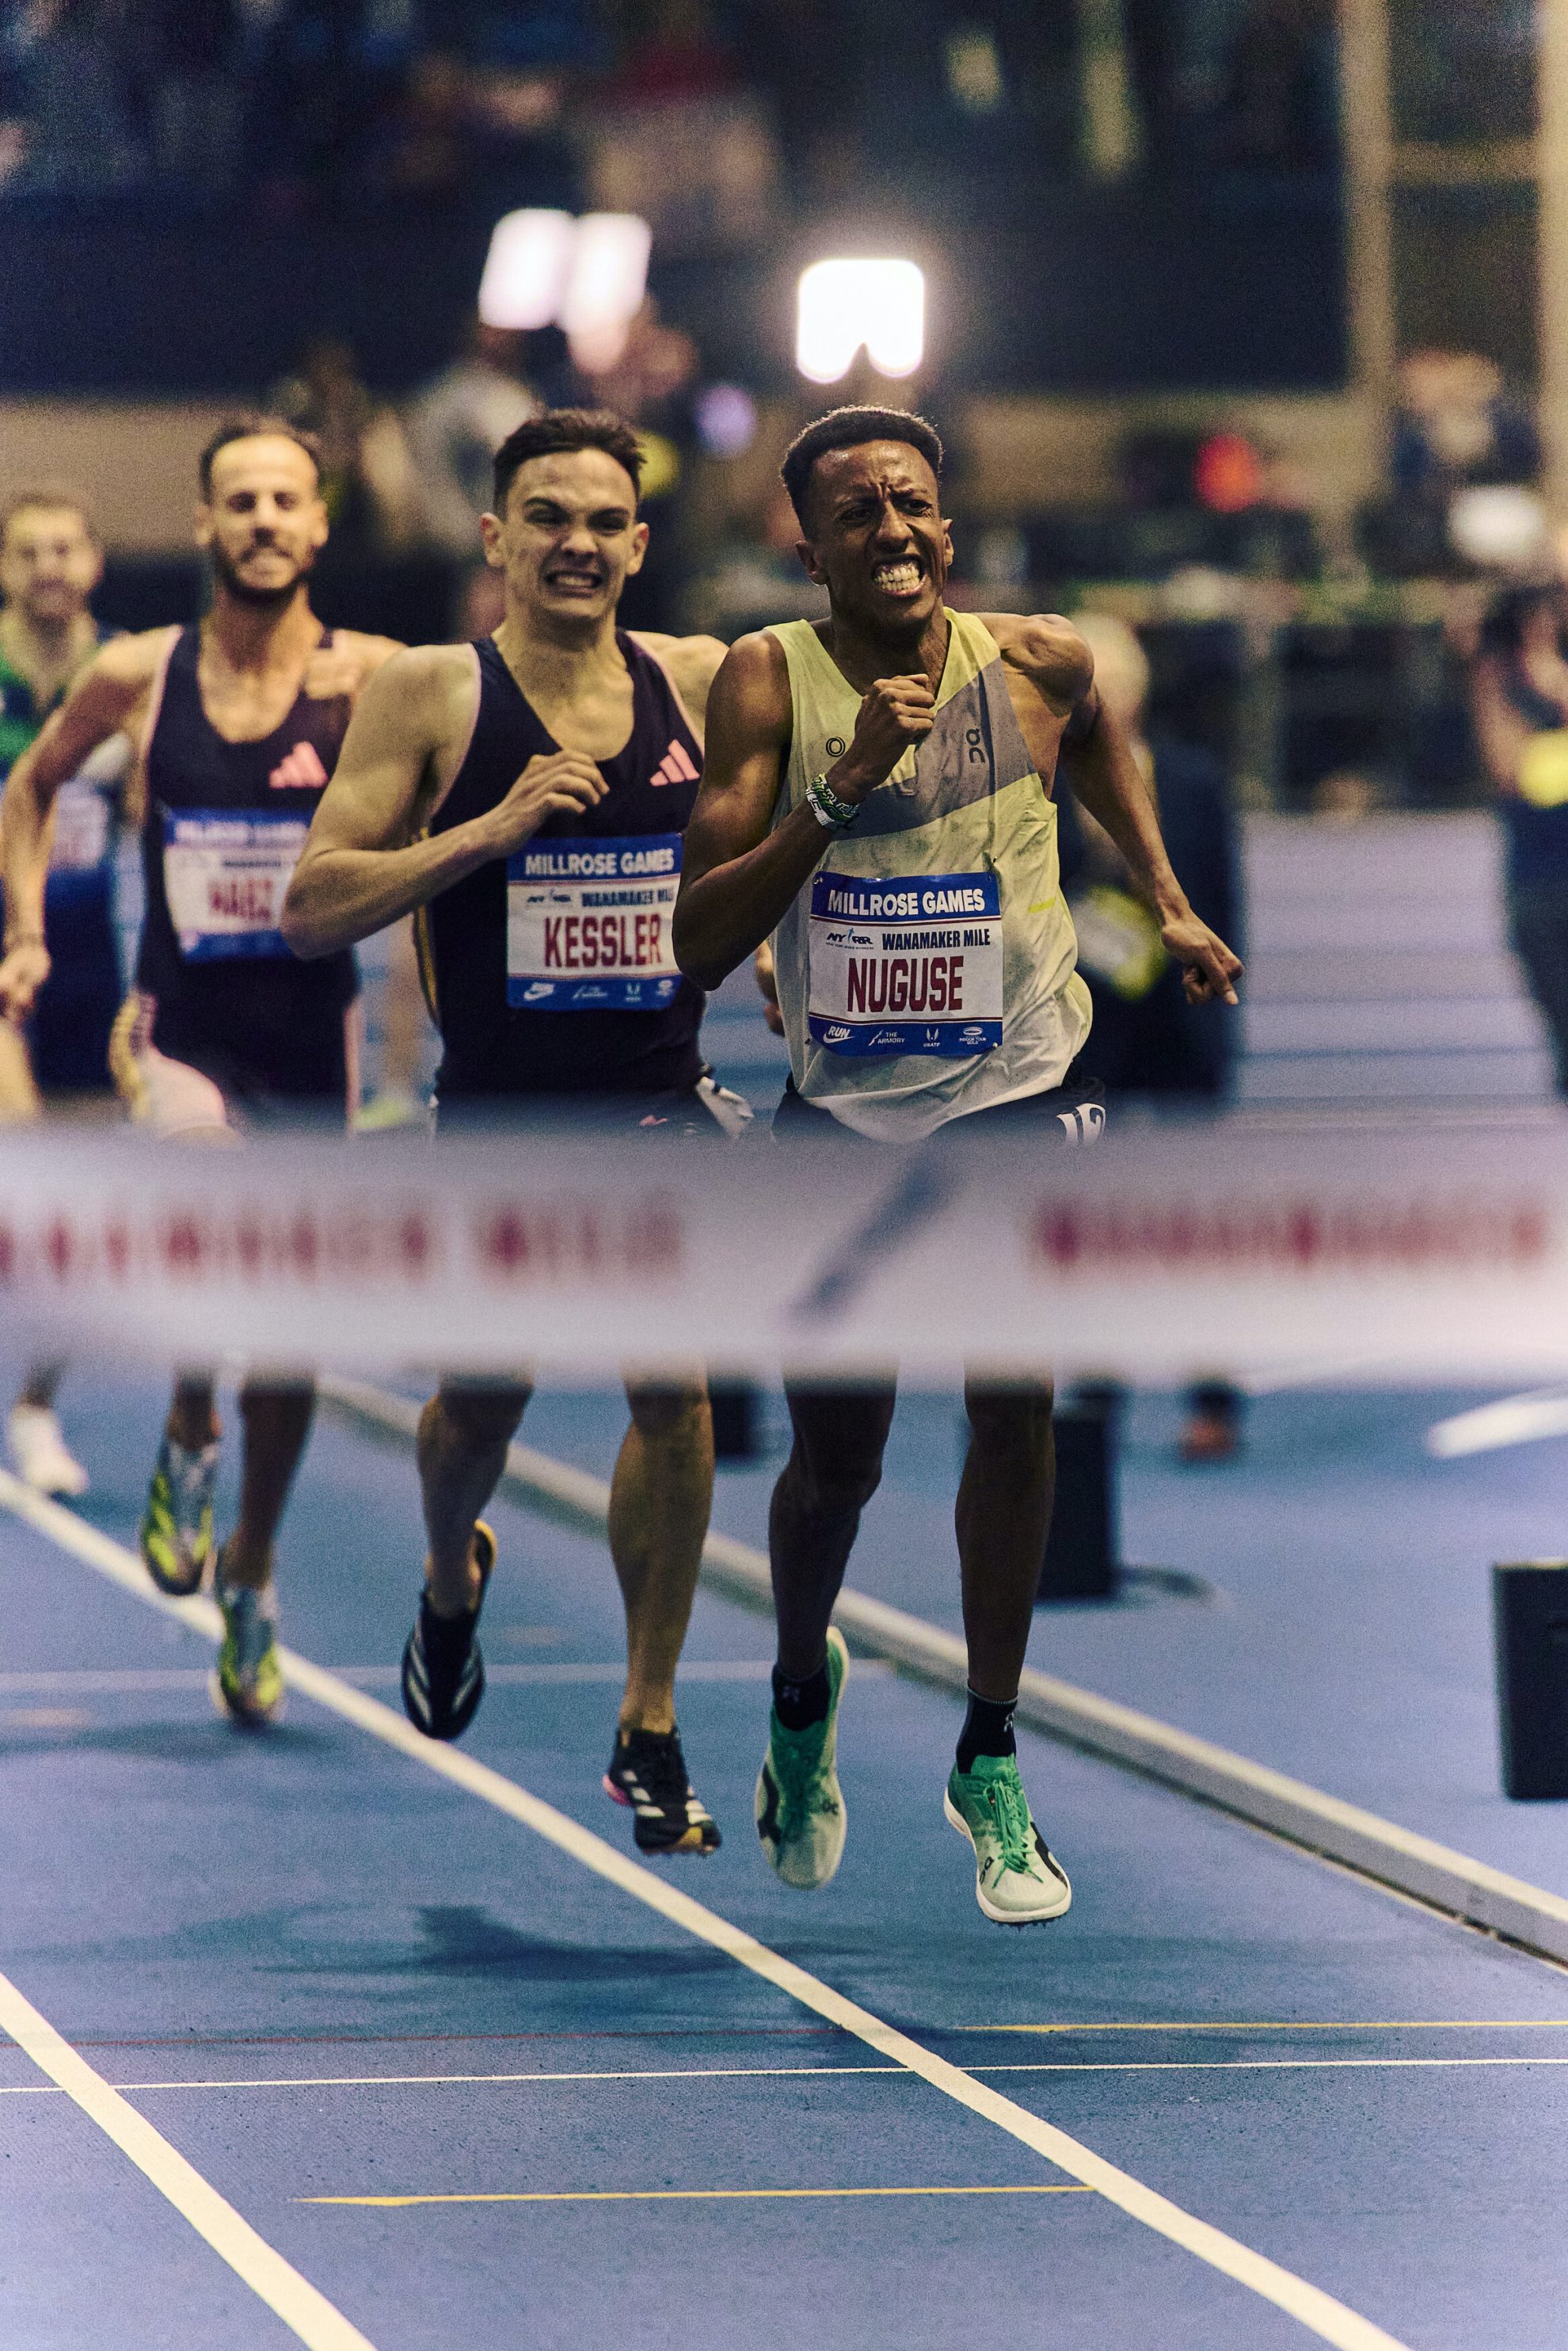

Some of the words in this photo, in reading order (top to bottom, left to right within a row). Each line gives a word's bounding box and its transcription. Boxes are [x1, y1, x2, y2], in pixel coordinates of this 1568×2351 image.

[525, 852, 618, 876] MILLROSE
[620, 848, 674, 874] GAMES
[828, 889, 919, 917] MILLROSE
[922, 888, 986, 913] GAMES
[545, 913, 662, 968] KESSLER
[881, 930, 961, 951] WANAMAKER
[963, 928, 991, 947] MILE
[847, 955, 965, 1013] NUGUSE
[828, 1025, 851, 1038] RUN
